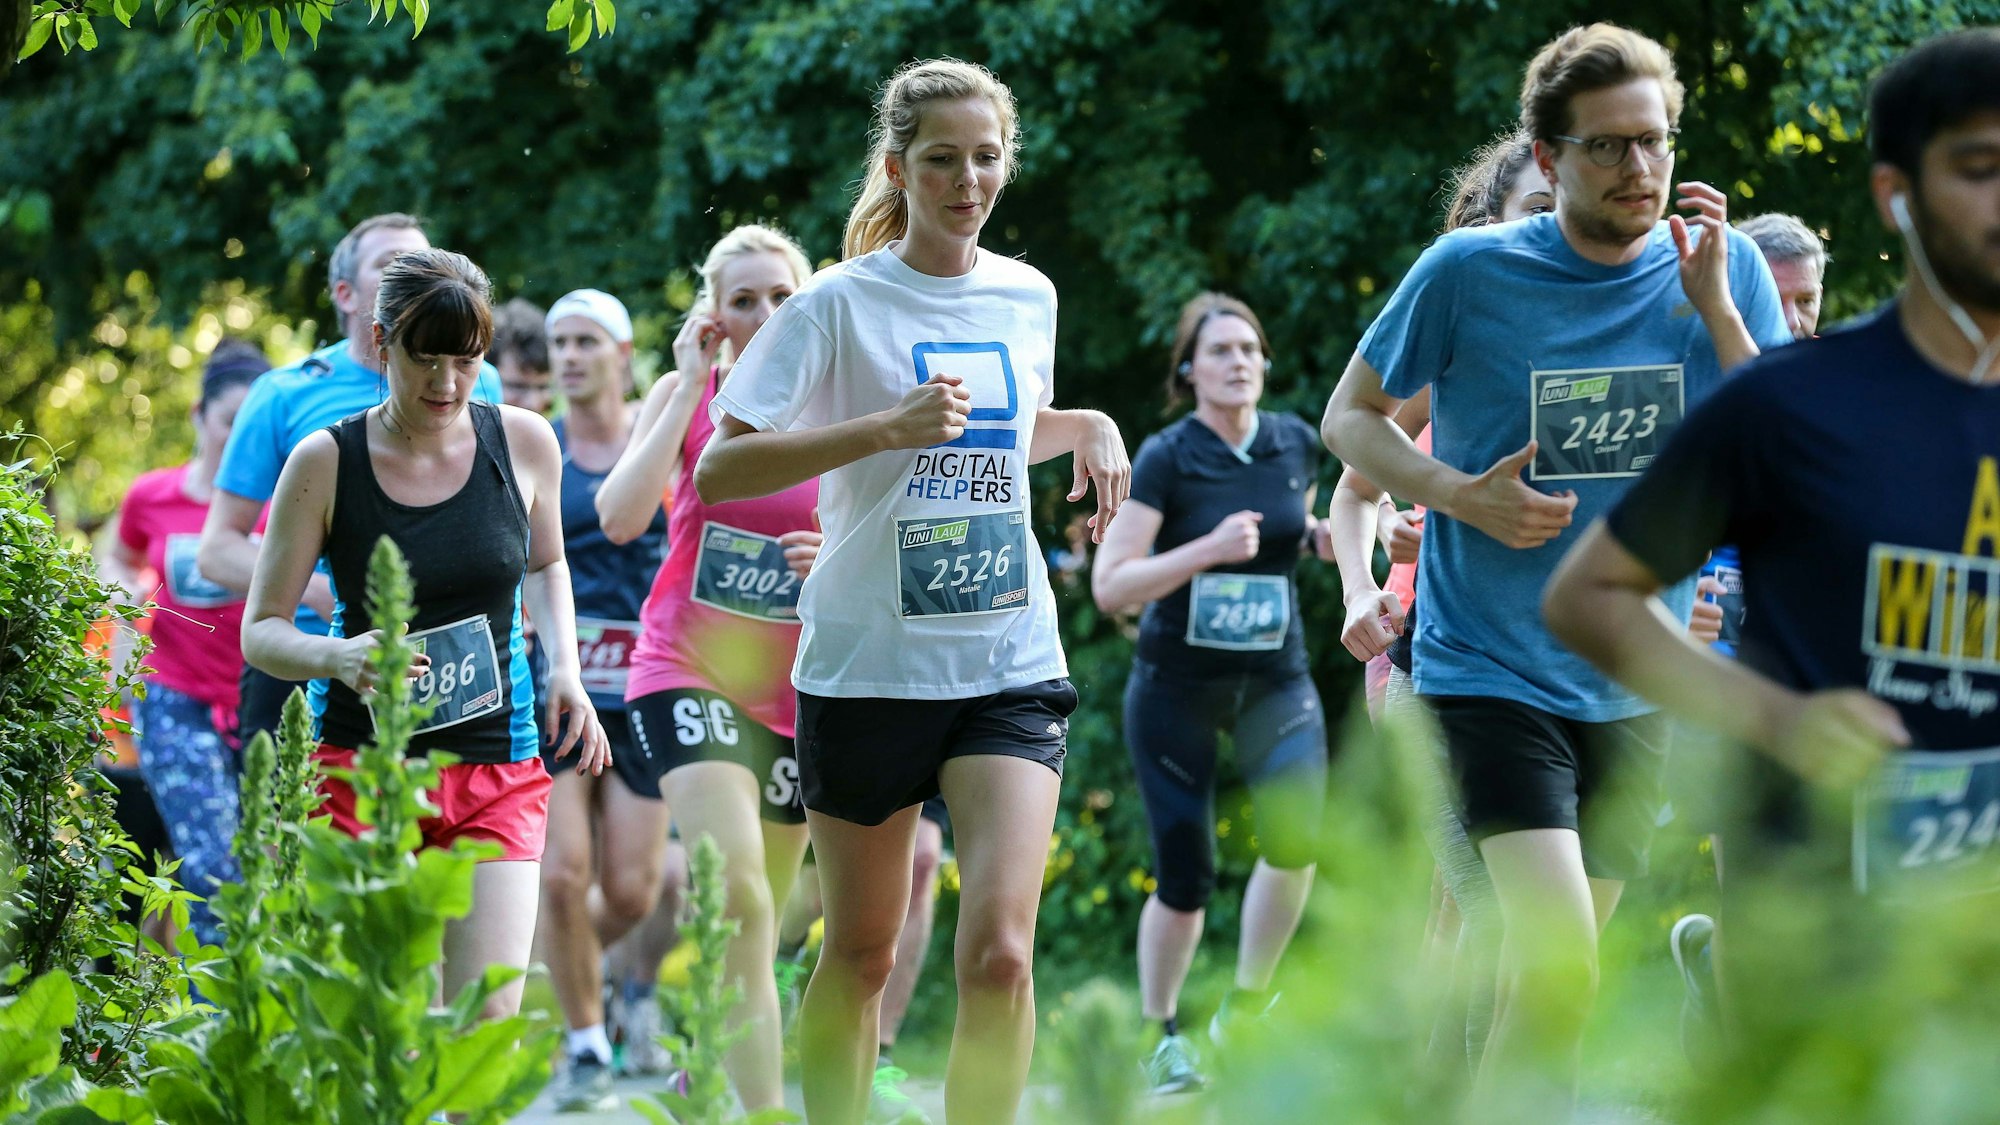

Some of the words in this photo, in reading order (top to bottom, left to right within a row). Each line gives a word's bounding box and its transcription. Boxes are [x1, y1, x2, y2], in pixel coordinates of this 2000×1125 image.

[1545, 386, 1570, 400] UNI
[1574, 380, 1607, 397] LAUF
[1561, 403, 1660, 450] 2423
[913, 452, 1012, 480] DIGITAL
[907, 477, 1012, 503] HELPERS
[907, 530, 930, 545] UNI
[934, 524, 966, 540] LAUF
[716, 563, 798, 596] 3002
[927, 544, 1012, 591] 2526
[959, 584, 981, 594] Natalie
[1209, 600, 1274, 630] 2636
[765, 757, 800, 808] S
[1899, 799, 2000, 868] 224
